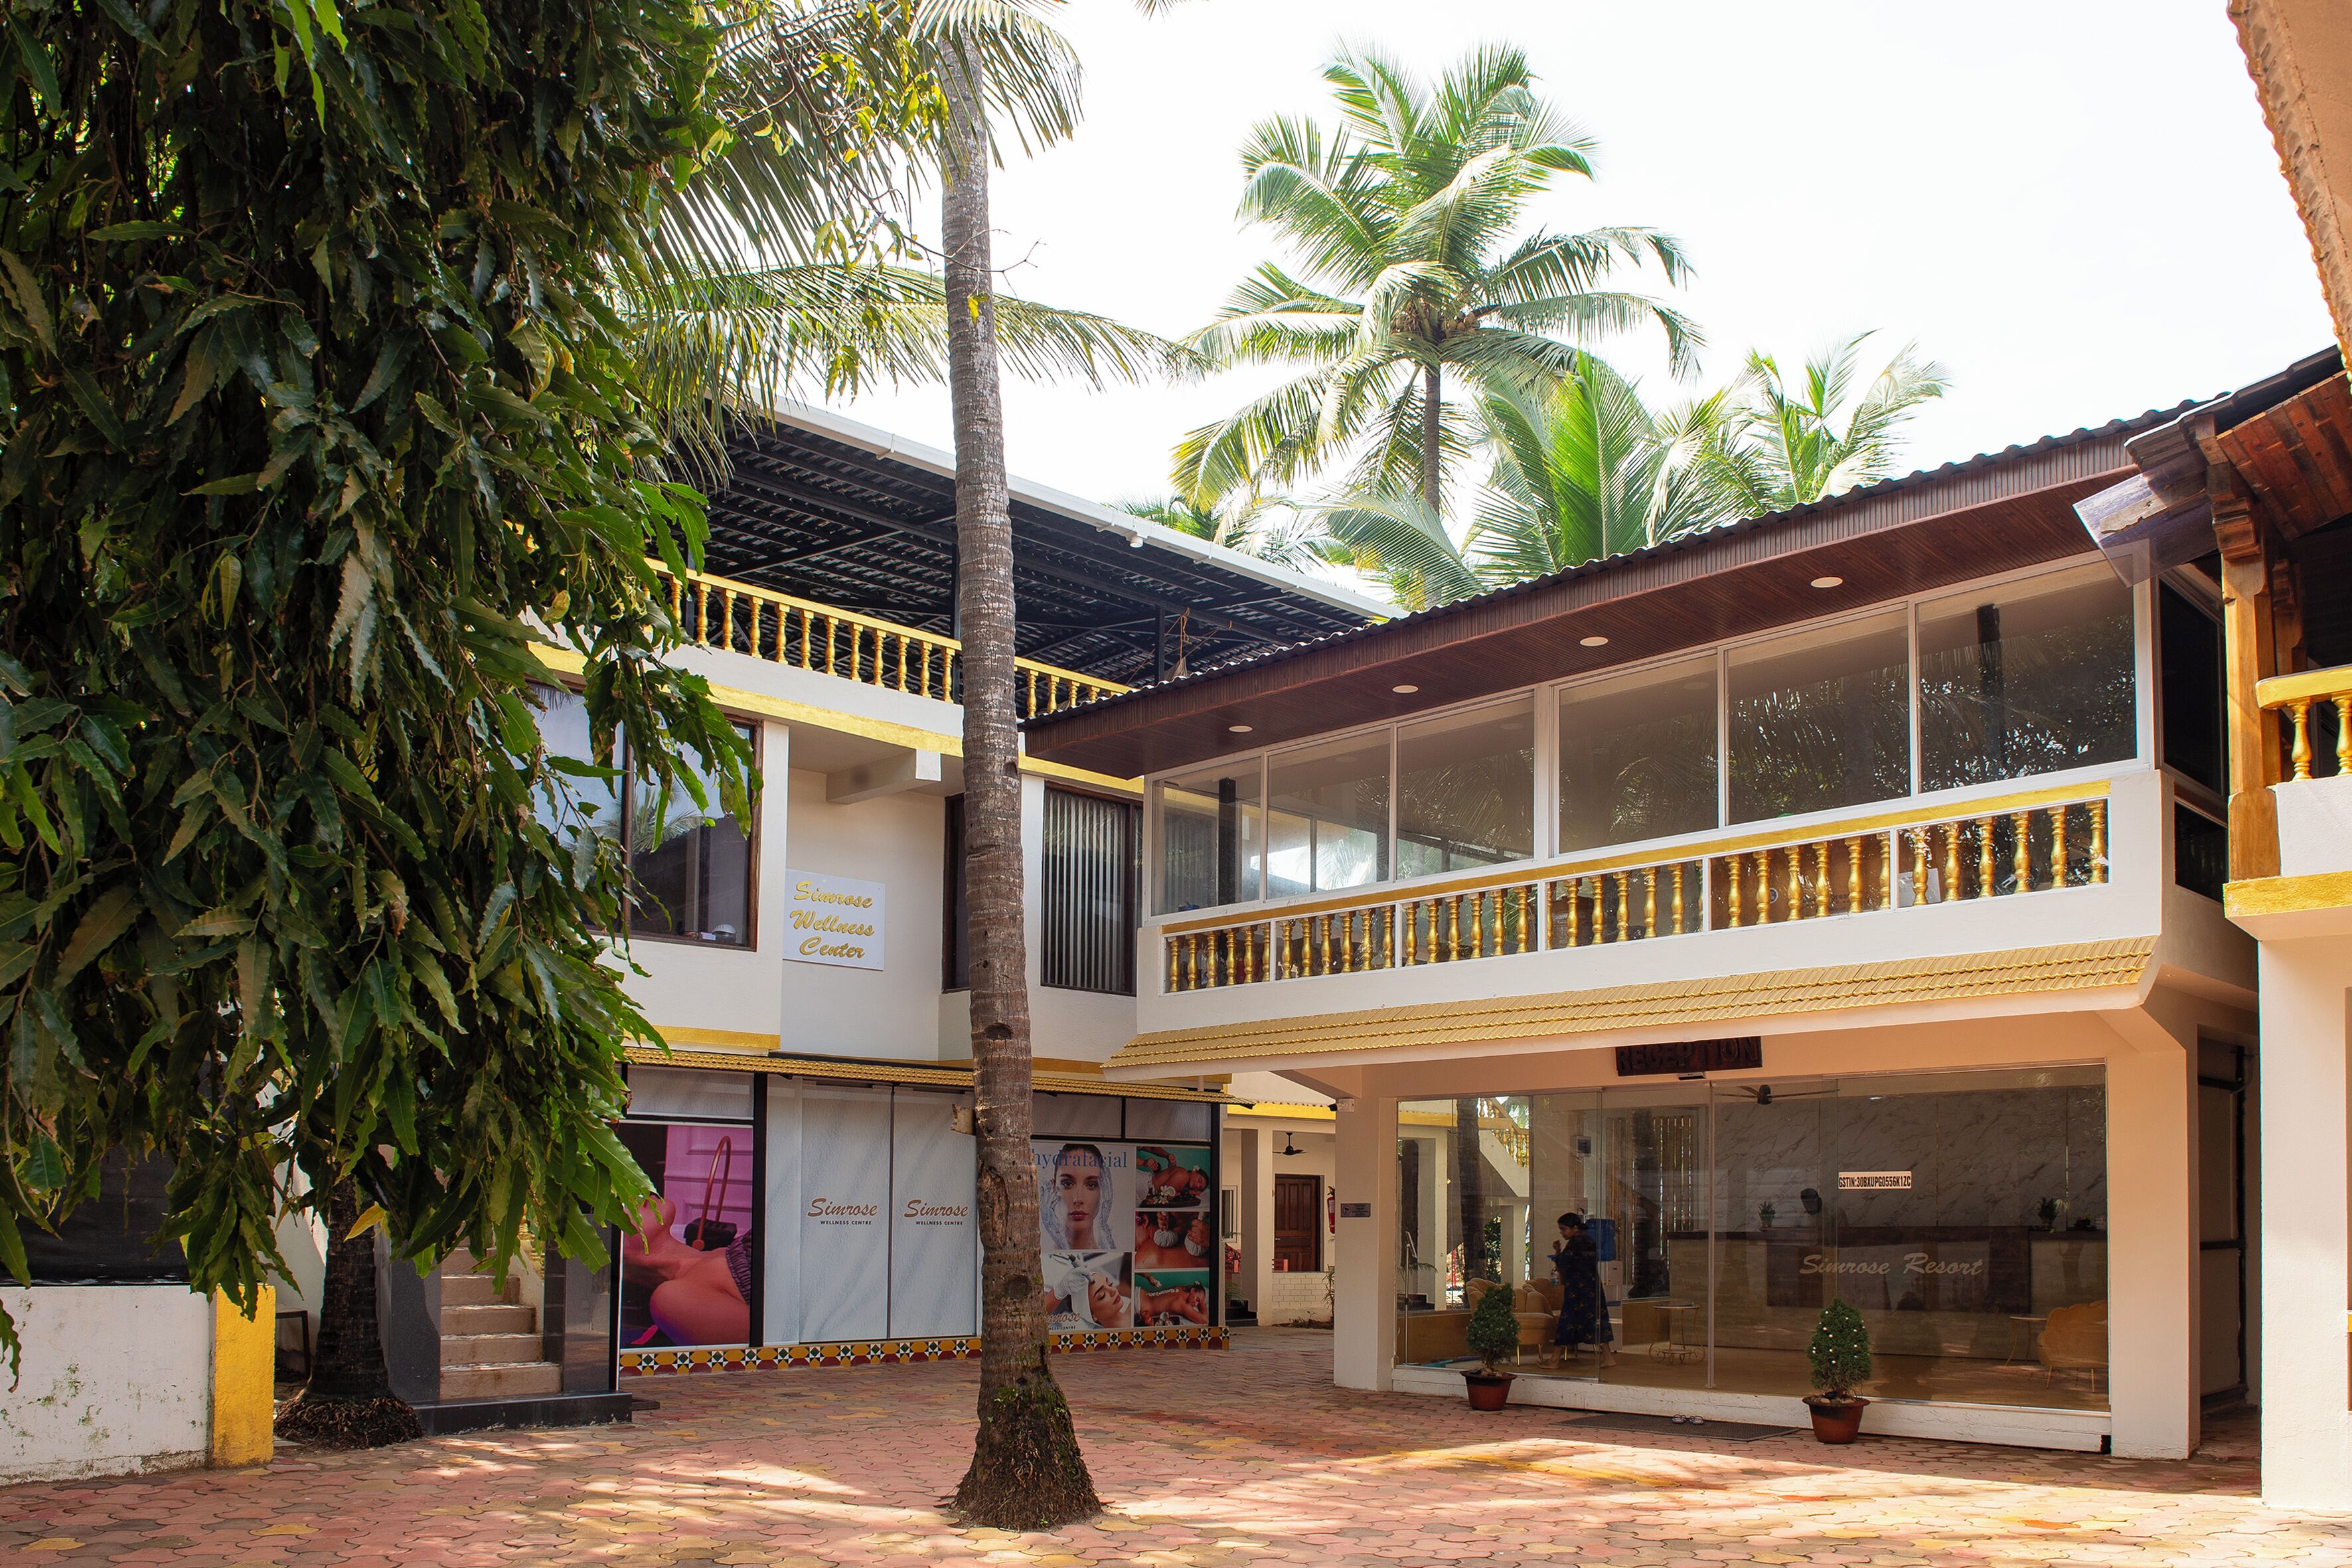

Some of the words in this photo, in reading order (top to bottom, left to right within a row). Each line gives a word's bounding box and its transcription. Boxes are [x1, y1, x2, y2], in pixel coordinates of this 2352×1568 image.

[794, 880, 873, 908] Simrose
[790, 909, 874, 936] Wellness
[799, 936, 865, 958] Center
[1618, 1038, 1759, 1071] RECEPTION
[807, 1198, 878, 1217] Simrose
[904, 1199, 969, 1218] Simrose
[1799, 1253, 1891, 1275] Simrose
[1903, 1252, 1984, 1275] Resort
